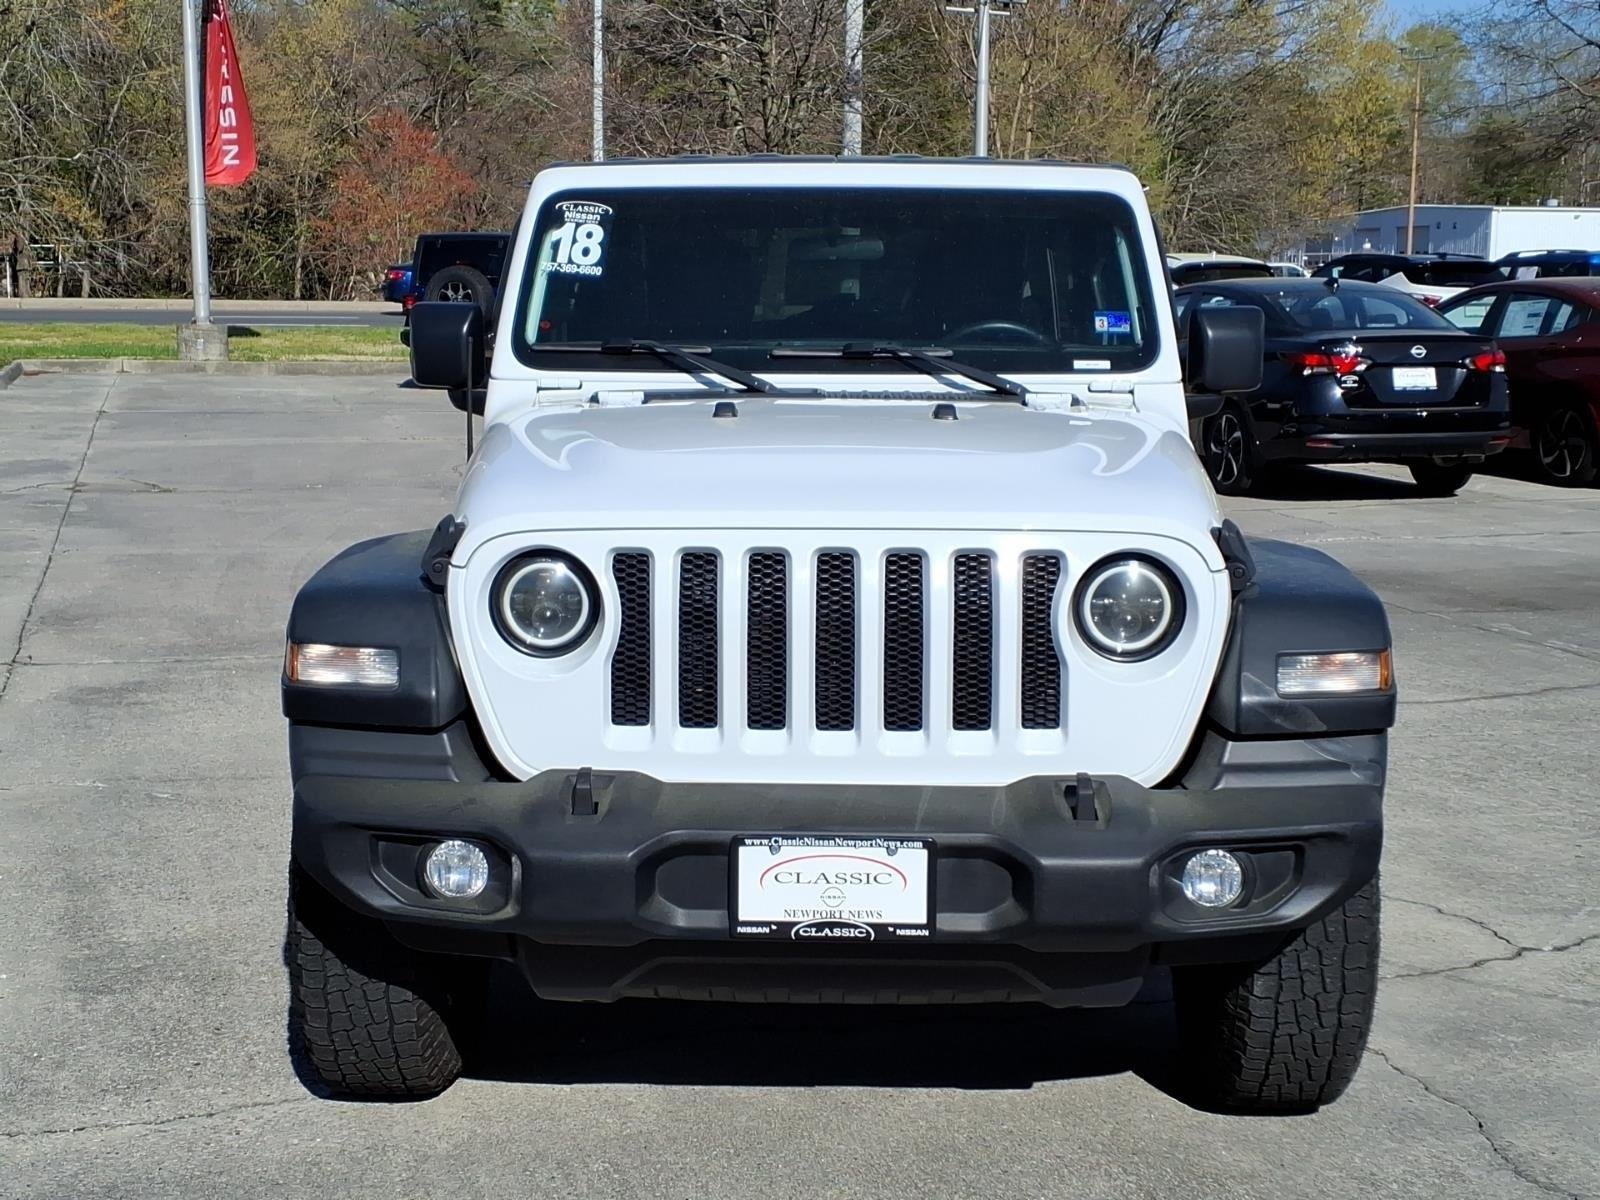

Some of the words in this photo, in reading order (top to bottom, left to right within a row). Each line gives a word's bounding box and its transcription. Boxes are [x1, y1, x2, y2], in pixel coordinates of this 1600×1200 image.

[562, 203, 606, 214] CLASSIC
[564, 211, 600, 221] Nissan
[551, 222, 604, 265] 18
[1098, 318, 1105, 328] 3
[744, 837, 923, 849] www.ClassicNissanNewportNews.com
[774, 872, 892, 885] CLASSIC
[783, 909, 846, 919] NEWPORT
[848, 910, 883, 919] NEWS
[737, 926, 770, 934] NISSAN
[799, 927, 867, 937] CLASSIC
[896, 928, 929, 936] NISSAN
